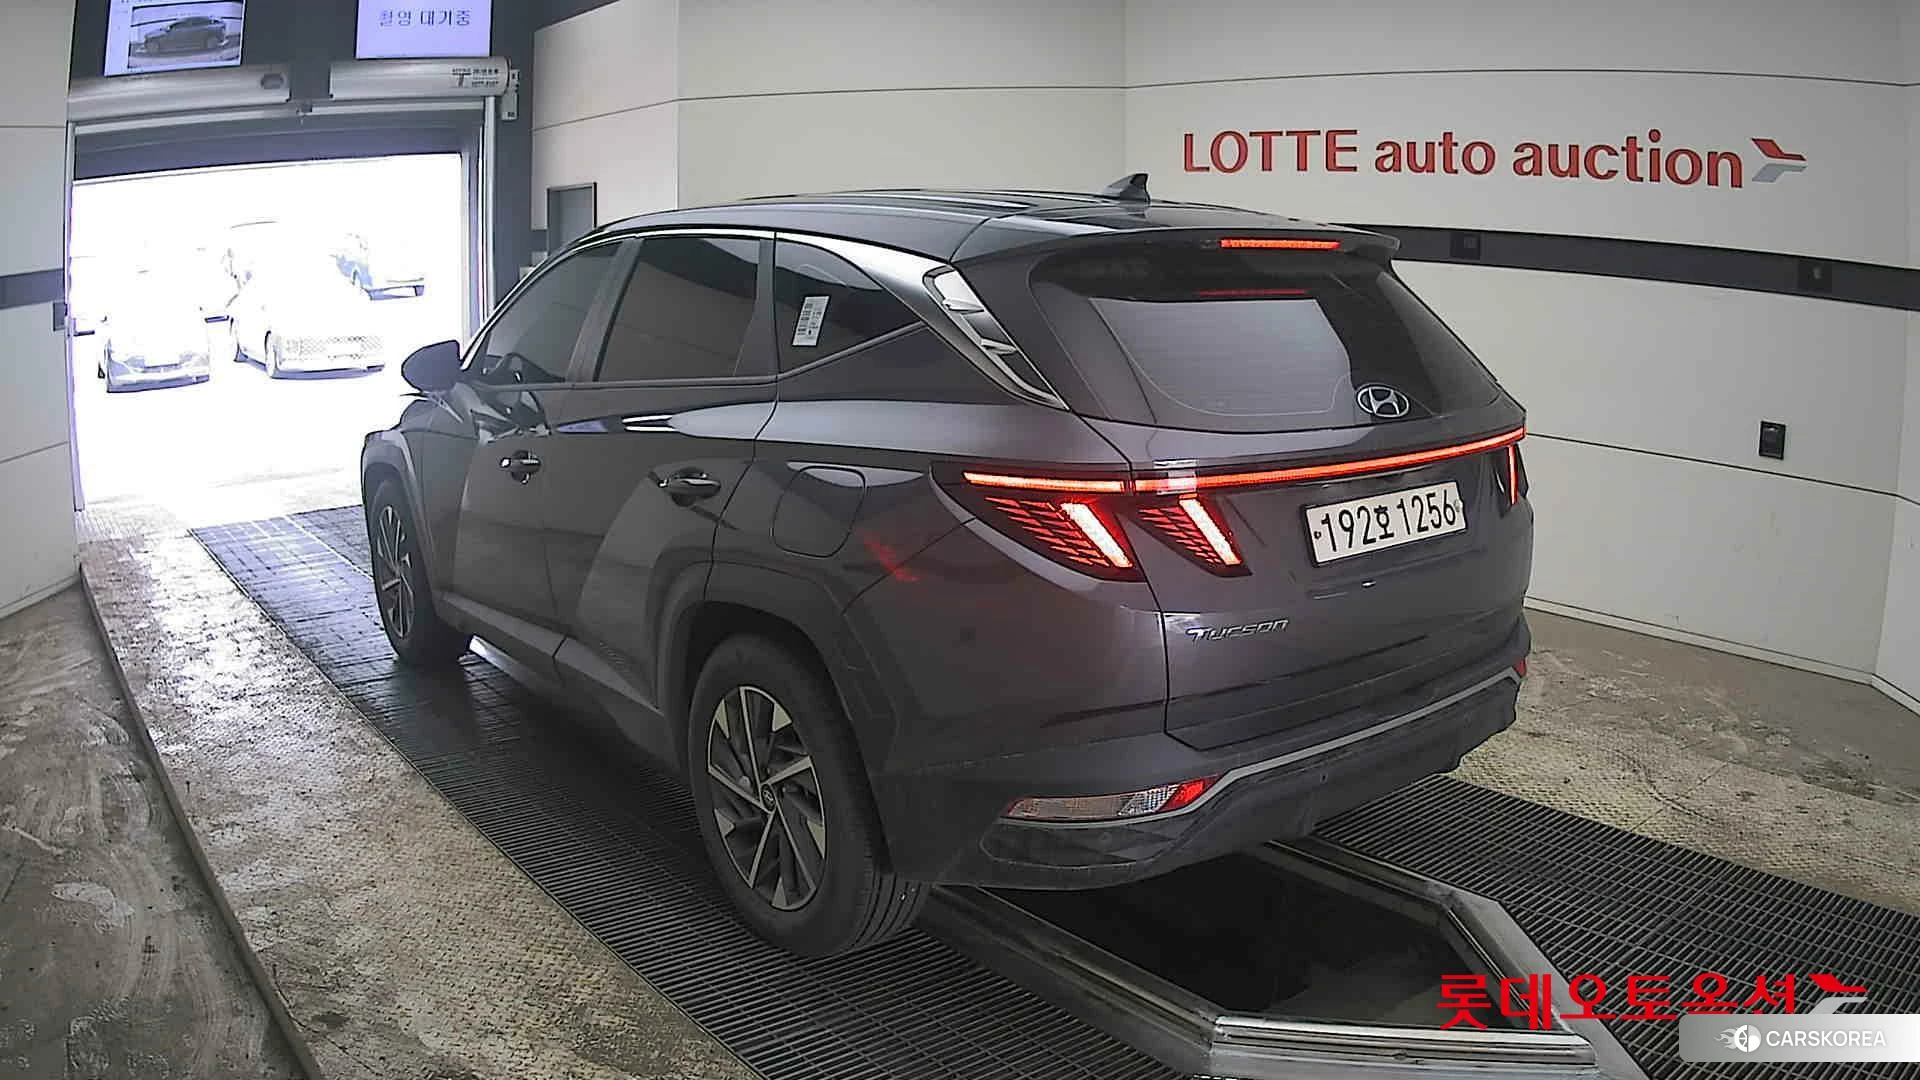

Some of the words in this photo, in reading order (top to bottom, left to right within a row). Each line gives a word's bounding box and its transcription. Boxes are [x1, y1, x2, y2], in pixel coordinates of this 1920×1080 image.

[1184, 130, 1358, 172] LOTTE
[1376, 131, 1495, 174] auto
[1514, 129, 1743, 188] auction
[1321, 505, 1394, 552] 192호
[1397, 490, 1455, 535] 1256
